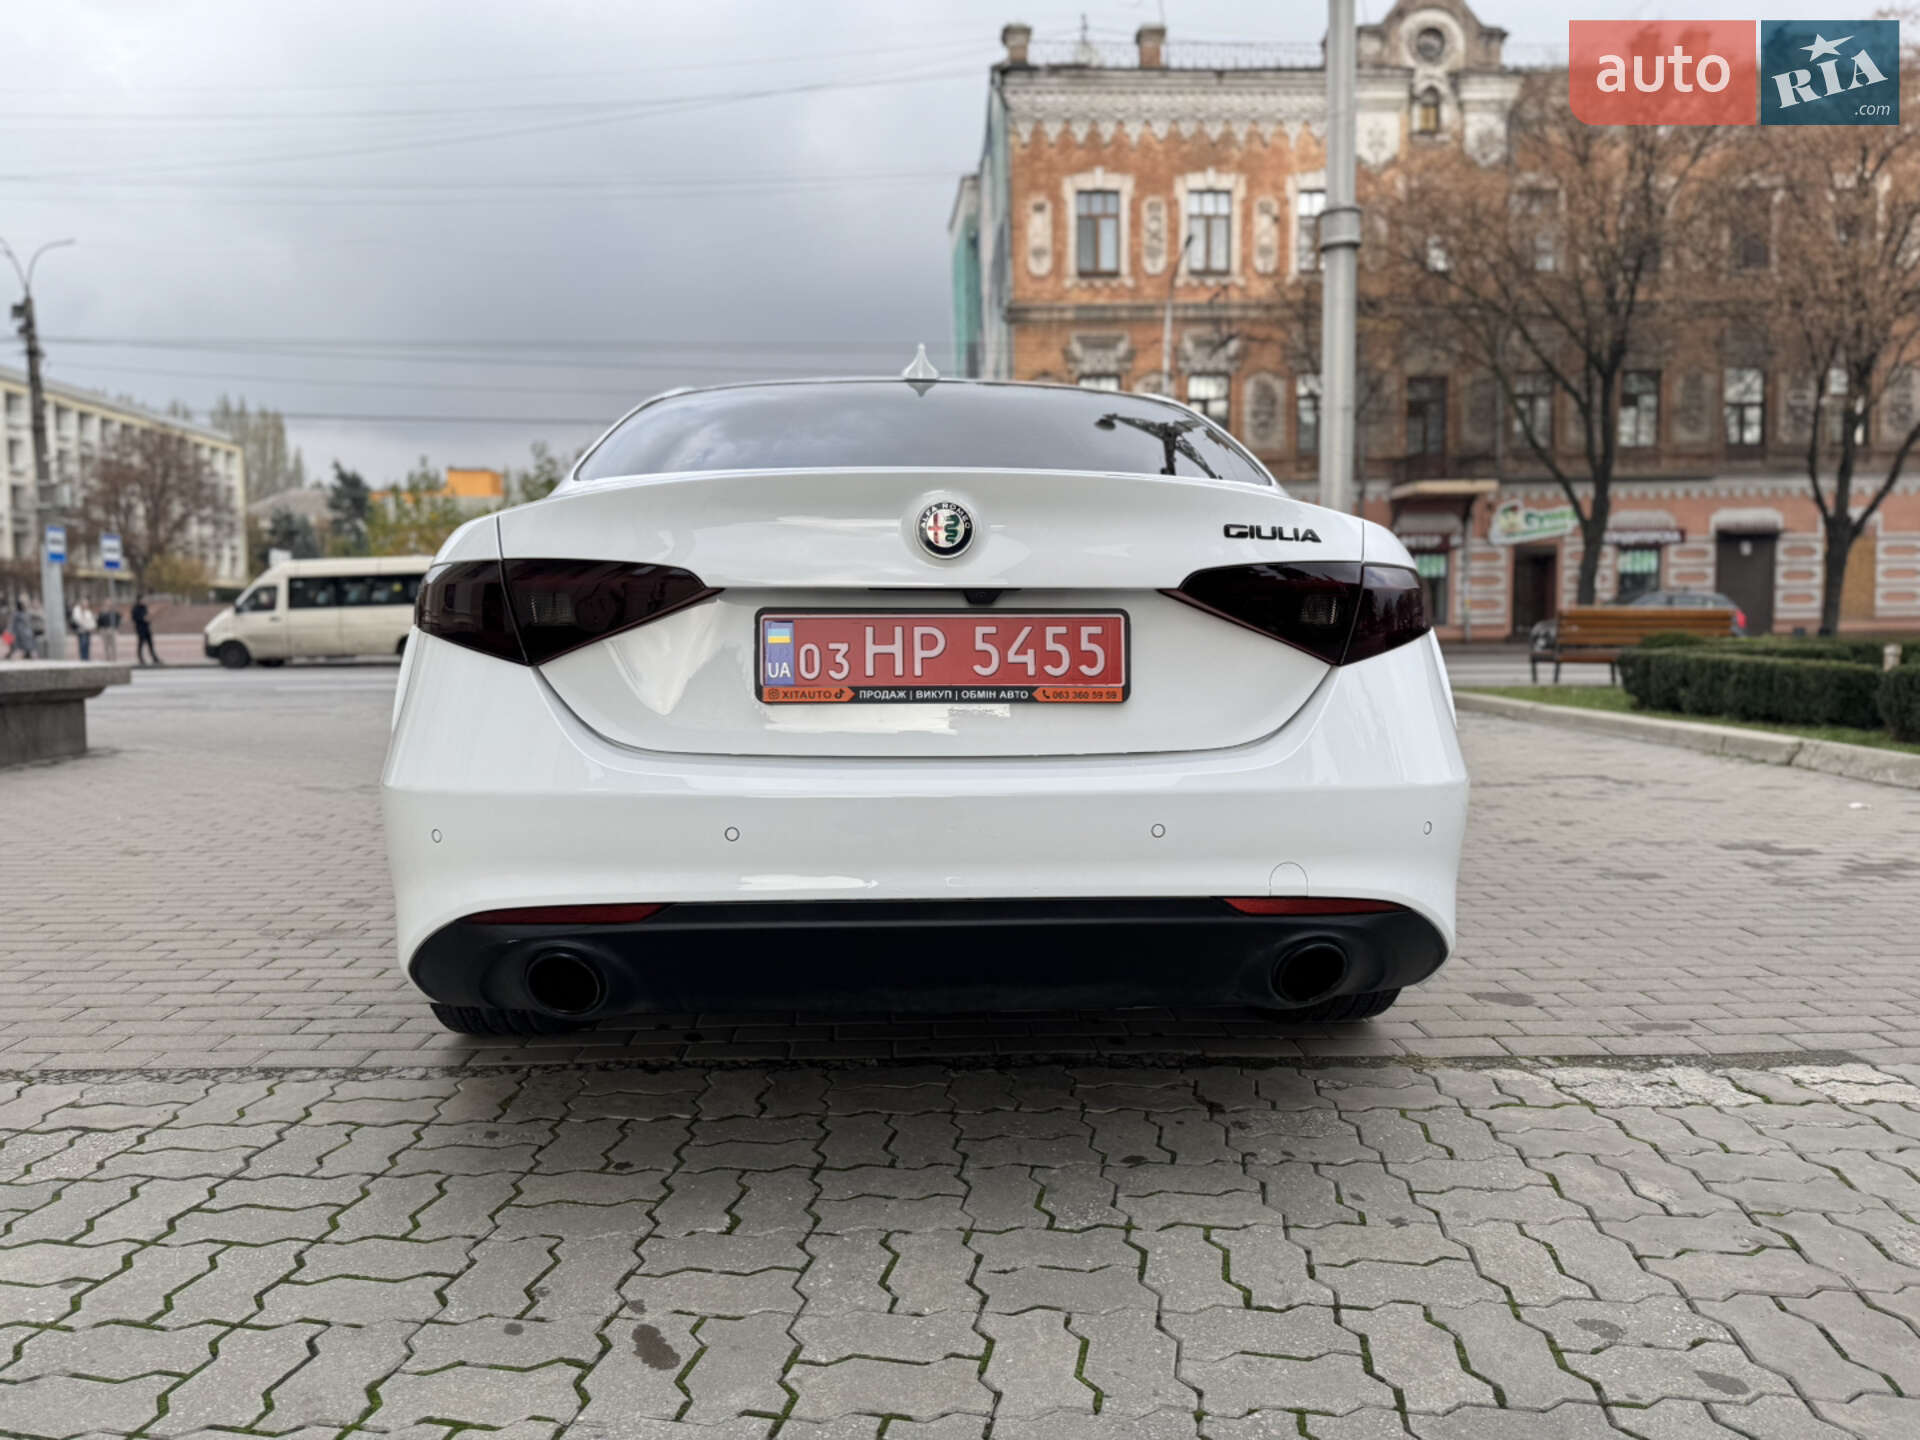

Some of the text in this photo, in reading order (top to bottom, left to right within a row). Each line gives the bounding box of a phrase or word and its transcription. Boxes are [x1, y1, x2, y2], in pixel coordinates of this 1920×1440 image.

[1223, 524, 1322, 543] GIULIA
[799, 625, 1106, 681] 03 HP 5455
[767, 661, 791, 678] UA
[782, 690, 832, 699] XITAUTO
[859, 690, 1029, 700] ПРОДАЖ ВИКУП ОБМІН АВТО
